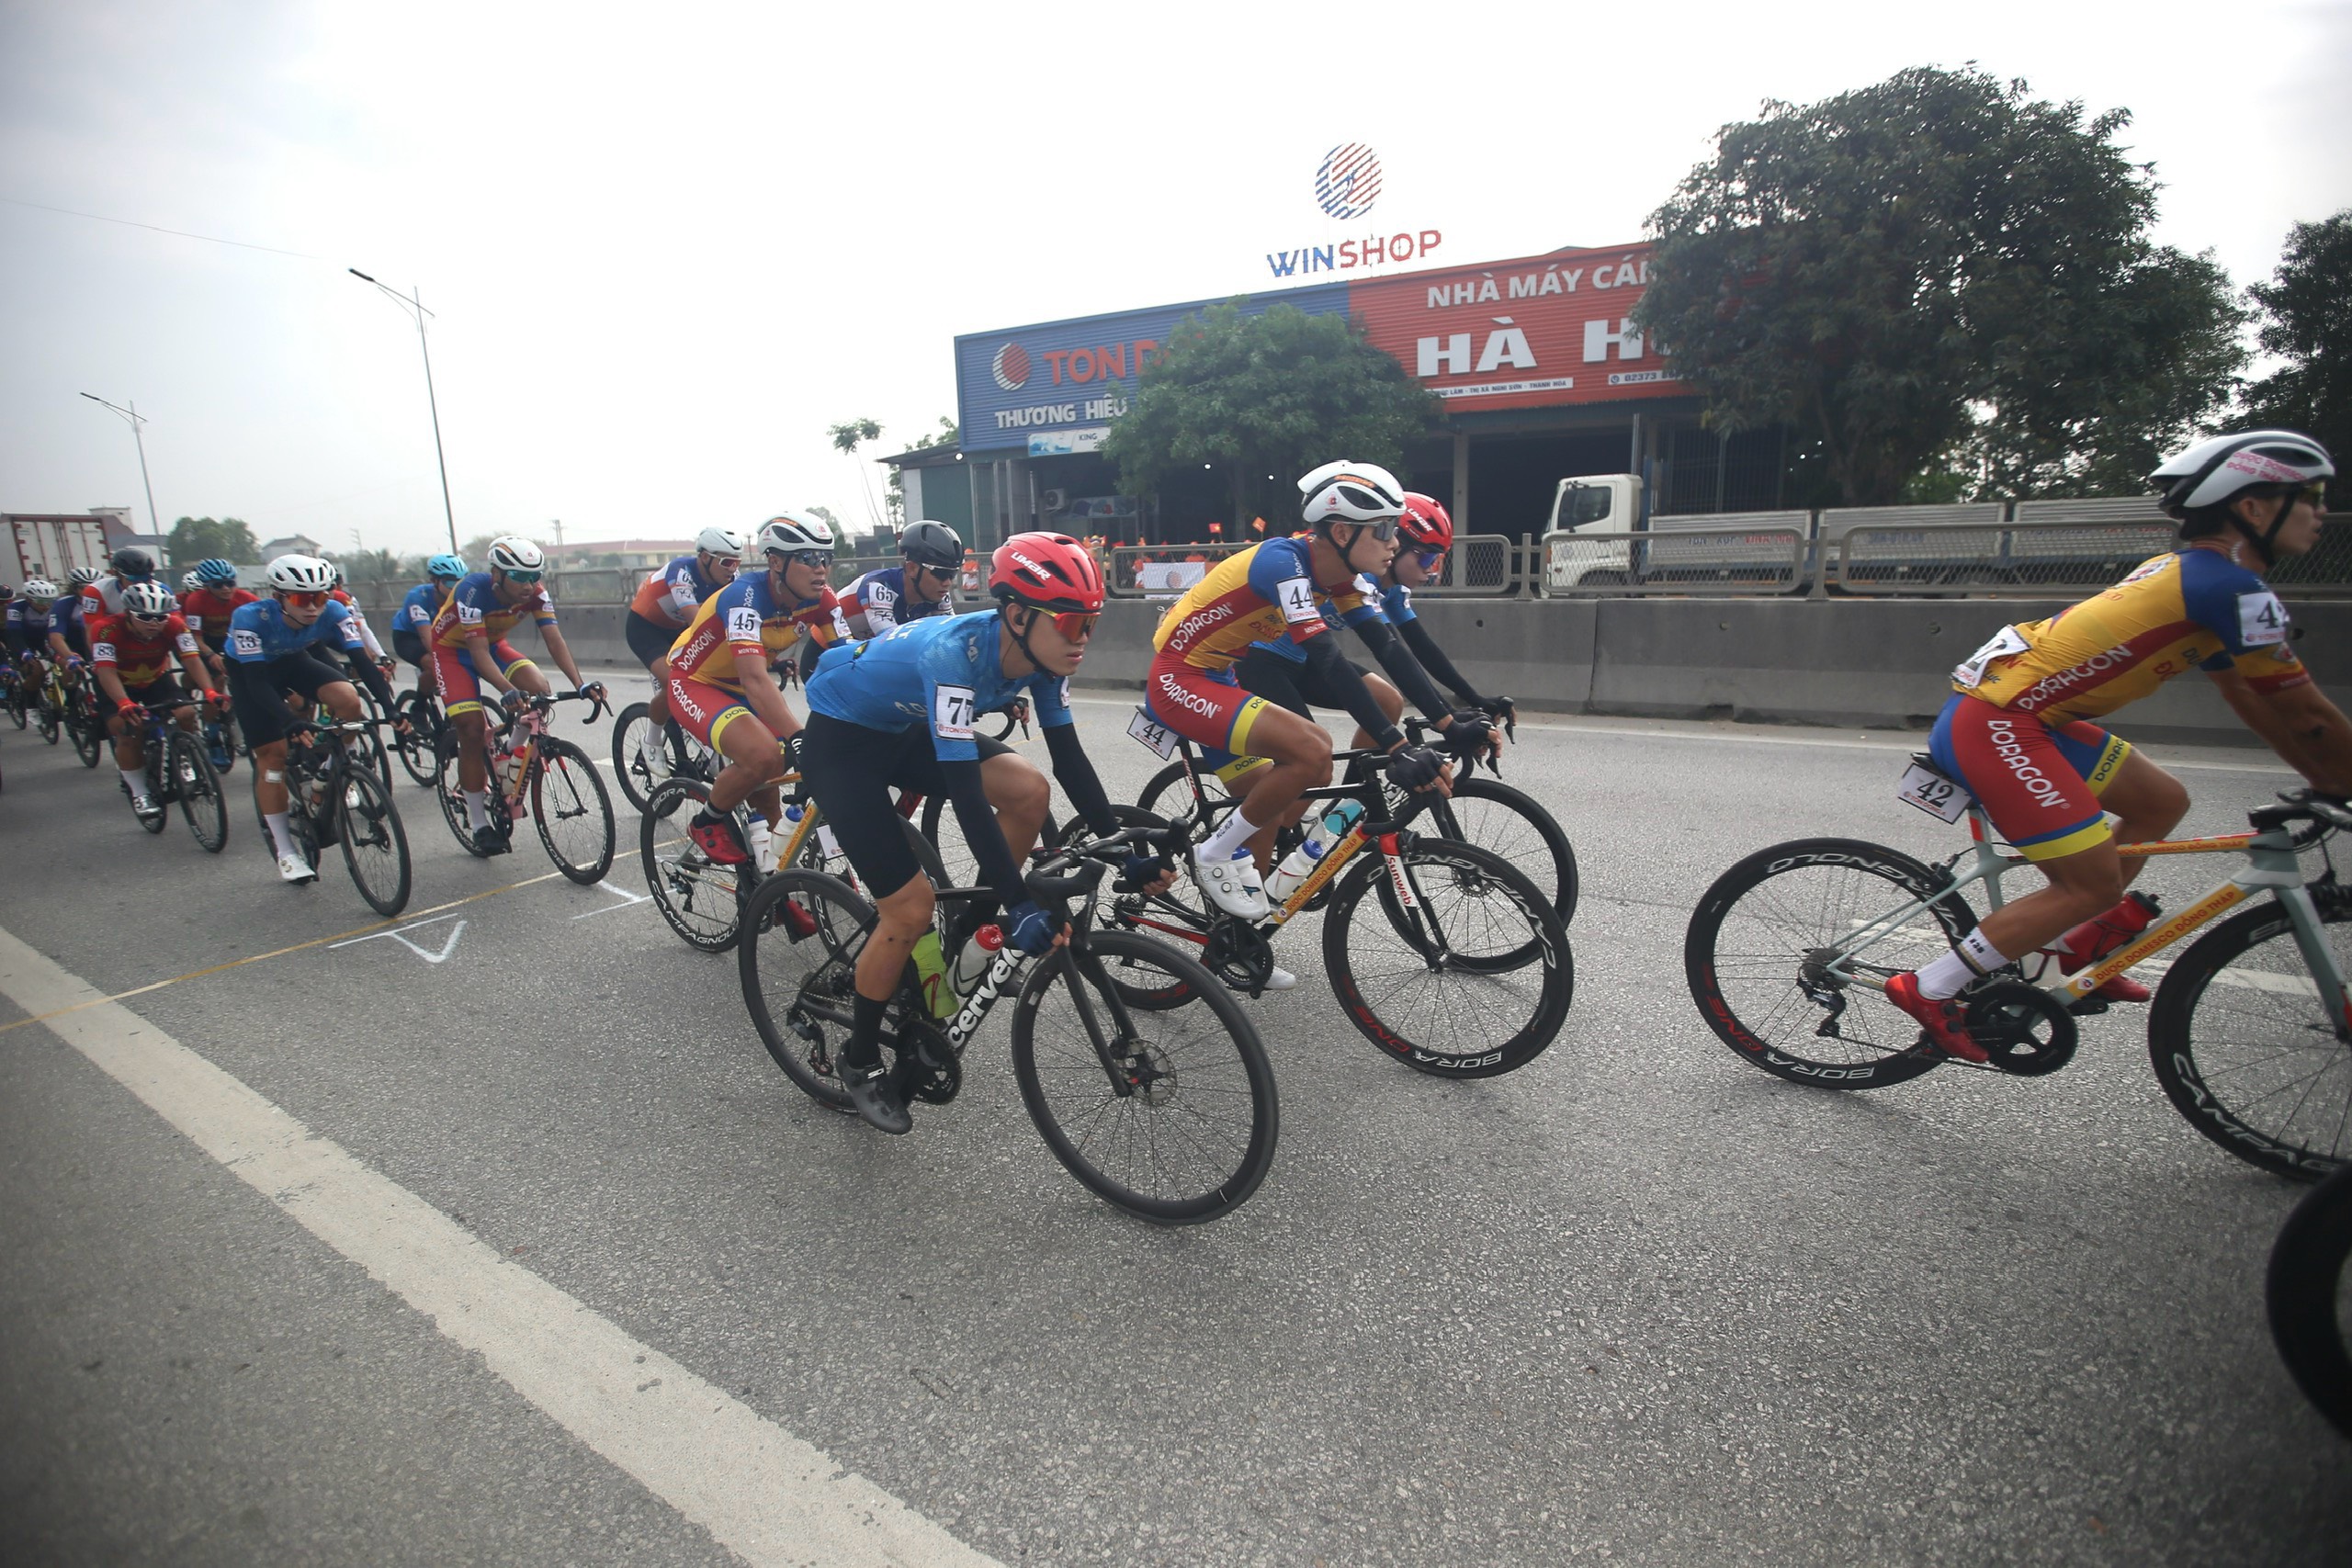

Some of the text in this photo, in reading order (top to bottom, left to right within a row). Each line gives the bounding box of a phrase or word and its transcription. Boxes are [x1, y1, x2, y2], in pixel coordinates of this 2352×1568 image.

[1267, 230, 1442, 277] WINSHOP
[1428, 272, 1499, 308] NHÀ
[1509, 264, 1584, 299] MÁY
[1417, 316, 1538, 378] HÀ
[1043, 343, 1125, 387] TON
[995, 404, 1076, 429] THƯƠNG
[876, 586, 893, 603] 65
[734, 613, 754, 632] 45
[1170, 604, 1232, 651] DORAGON
[97, 645, 115, 658] 83
[678, 629, 715, 671] DORAGON
[2017, 643, 2133, 711] DORAGON
[671, 679, 705, 723] DORAGON
[1159, 673, 1217, 718] DORAGON
[948, 696, 973, 727] 77
[1143, 724, 1166, 746] 44
[1987, 720, 2066, 808] DORAGON
[651, 787, 686, 812] BORA
[1917, 779, 1953, 807] 42
[1301, 870, 1327, 896] DOMESCO
[1387, 857, 1412, 905] Sunweb
[2125, 931, 2175, 962] DOMESCO
[1413, 1050, 1502, 1068] BORA
[1766, 1051, 1875, 1079] BORA
